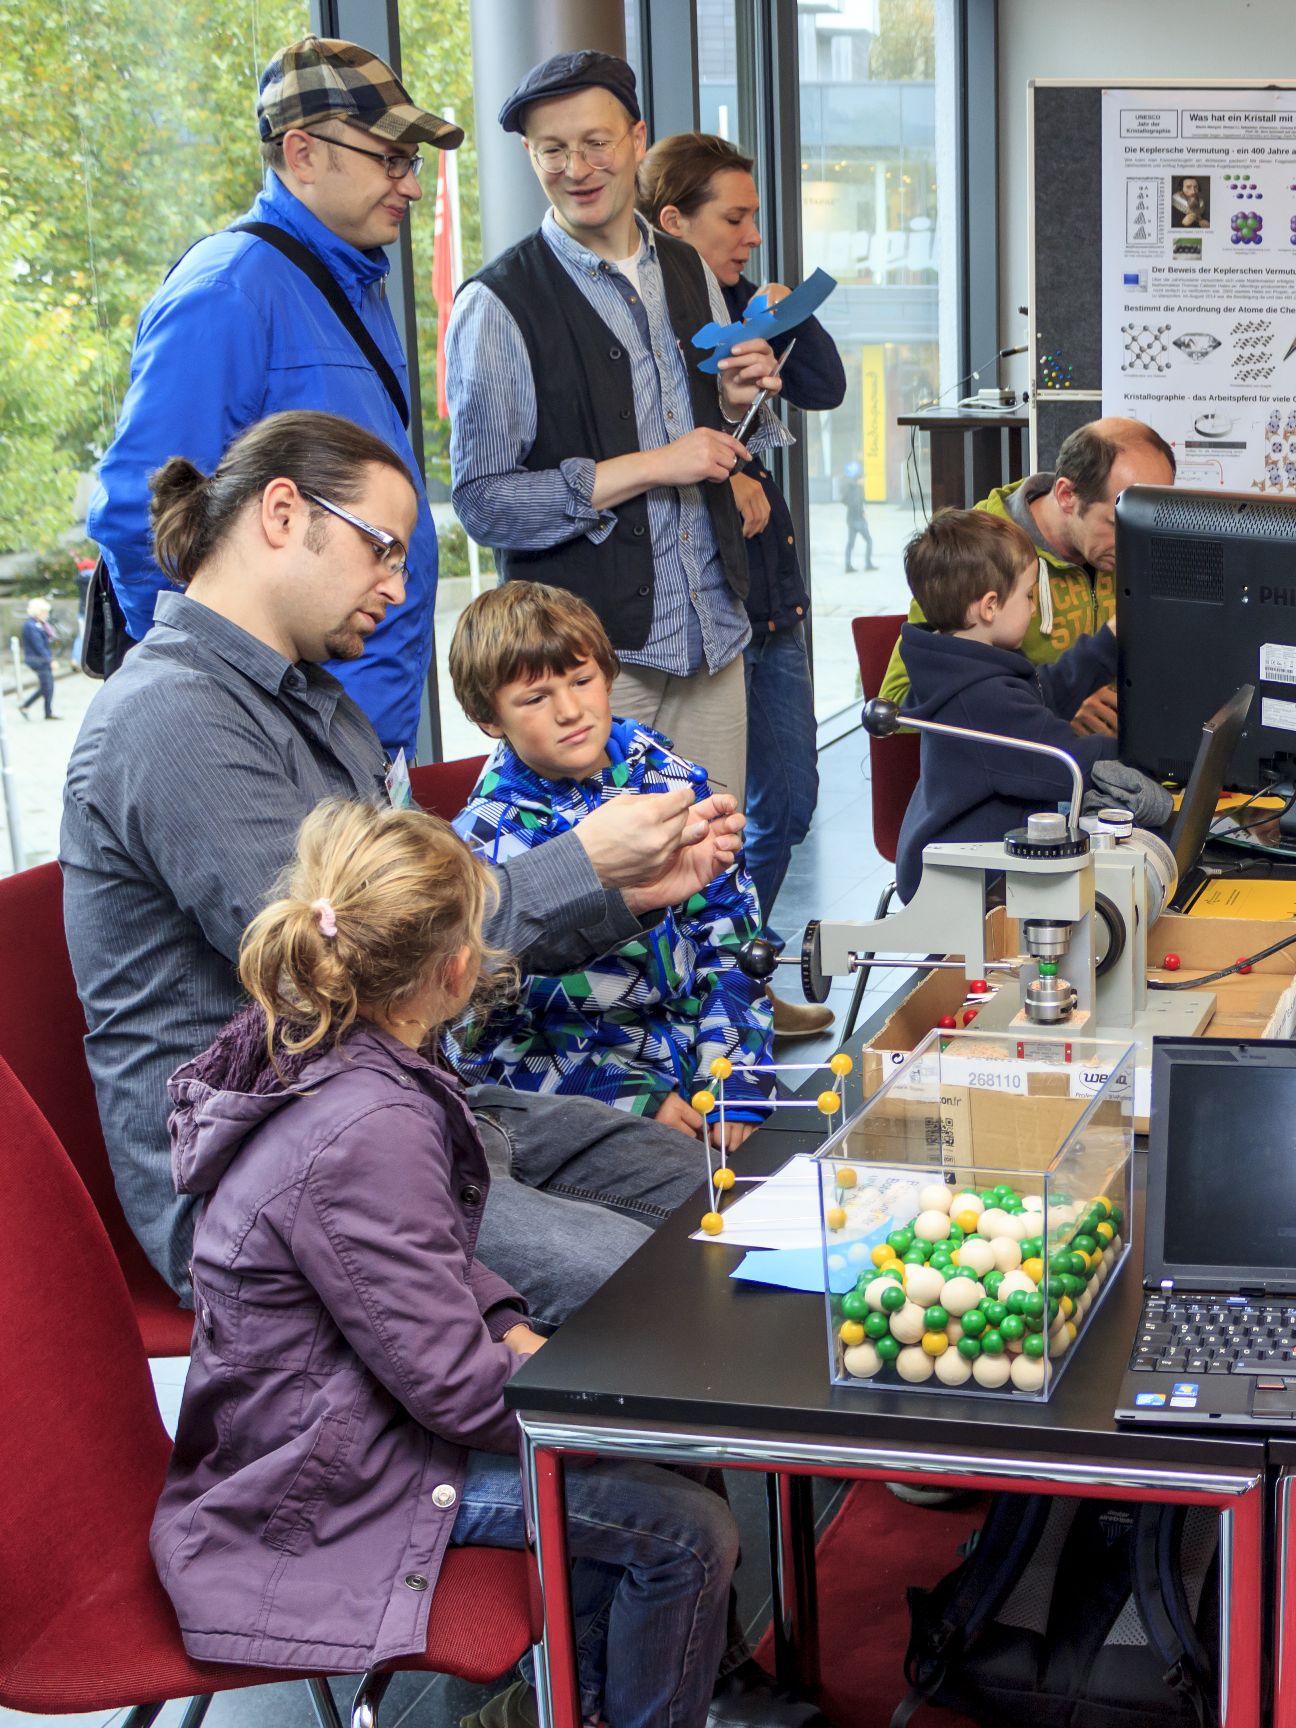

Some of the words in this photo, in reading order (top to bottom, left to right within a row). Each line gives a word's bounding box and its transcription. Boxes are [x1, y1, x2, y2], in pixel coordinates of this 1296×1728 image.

[1189, 113, 1208, 122] Was
[1211, 113, 1225, 122] hat
[1227, 113, 1241, 122] ein
[1244, 114, 1276, 122] Kristall
[1279, 114, 1292, 123] mit
[1124, 146, 1137, 154] Die
[1139, 147, 1183, 155] Keplersche
[1186, 147, 1229, 156] Vermutung
[1151, 266, 1165, 274] Der
[1167, 266, 1196, 274] Beweis
[1213, 267, 1263, 276] Keplerschen
[1123, 304, 1161, 312] Bestimmt
[1176, 305, 1221, 314] Anordnung
[1237, 306, 1263, 314] Atome
[1265, 306, 1278, 314] die
[1123, 393, 1185, 403] Kristallographie
[1192, 394, 1206, 402] das
[1208, 394, 1257, 404] Arbeitspferd
[968, 1071, 1021, 1089] 268110
